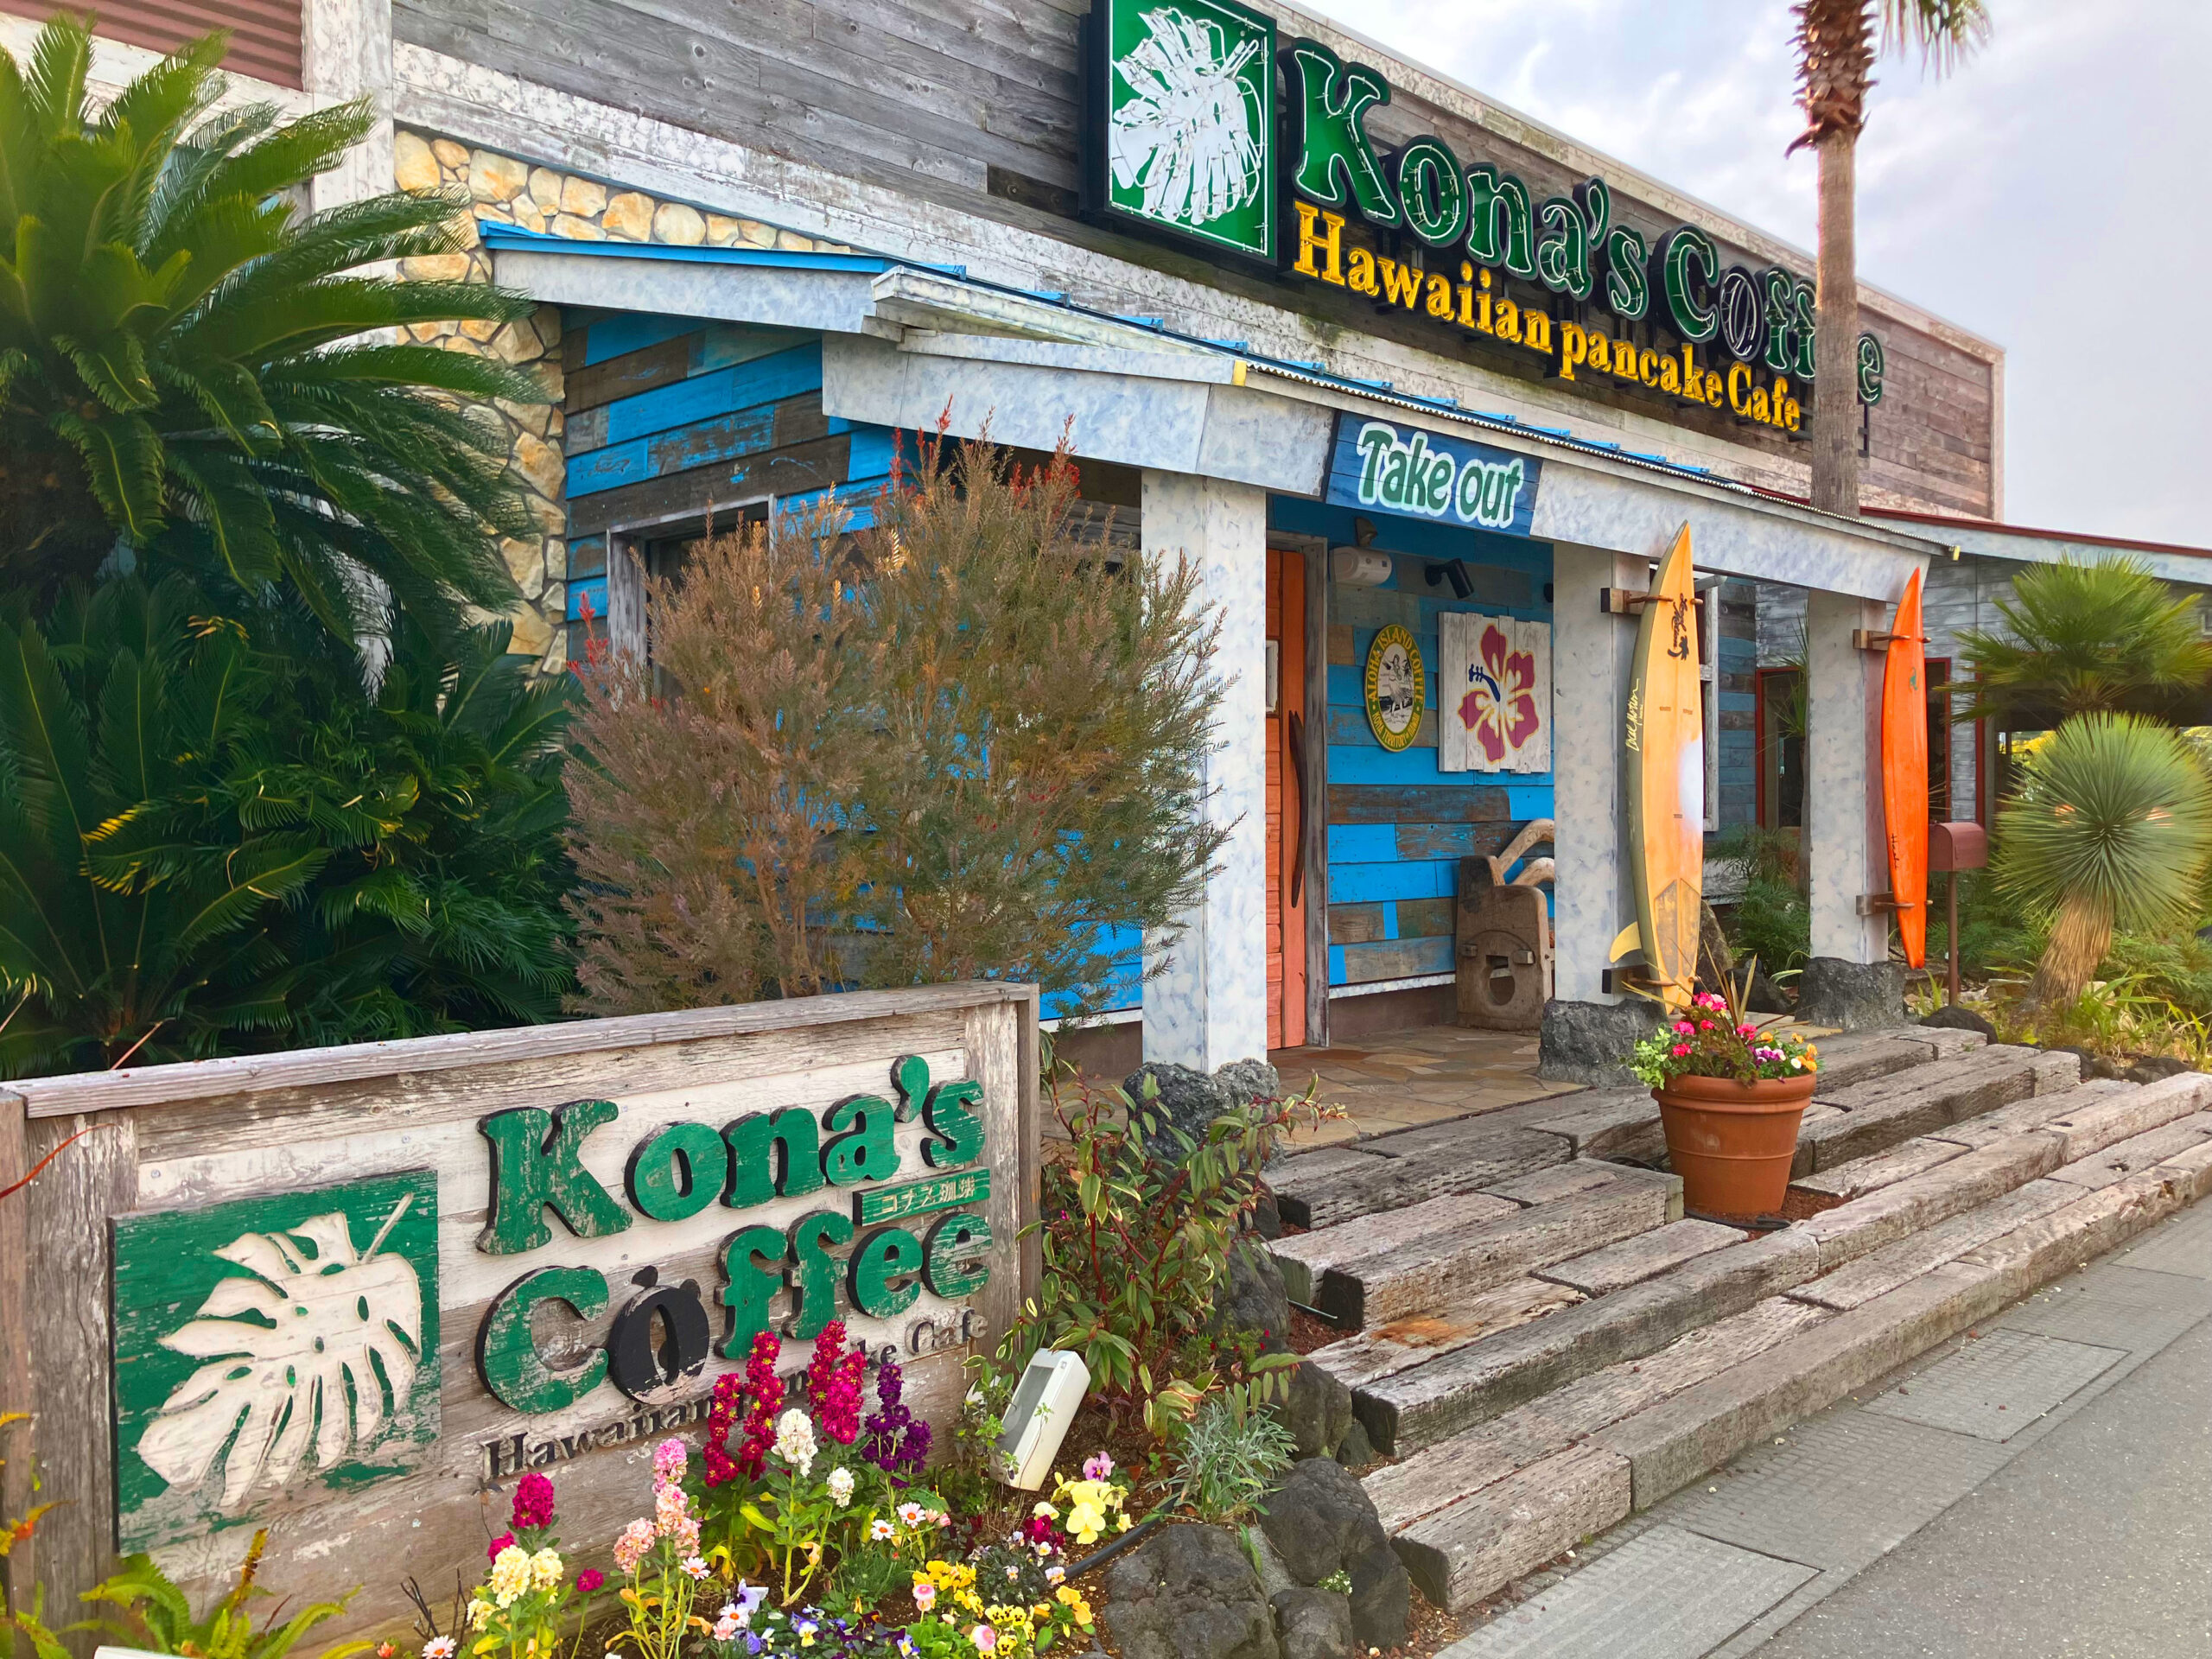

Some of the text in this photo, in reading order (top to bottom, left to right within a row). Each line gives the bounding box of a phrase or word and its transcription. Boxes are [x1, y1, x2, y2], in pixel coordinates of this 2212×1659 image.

[1286, 39, 1885, 407] Kona's Coffe
[1294, 200, 1801, 432] Hawaiian pancake Cafe
[1358, 423, 1523, 527] Take out
[1367, 627, 1424, 704] ALOHA ISLAND COFFEE
[1372, 711, 1384, 734] KONA
[476, 1054, 985, 1255] Kona's
[881, 1175, 976, 1213] コナス珈琲
[476, 1210, 994, 1414] Coffee
